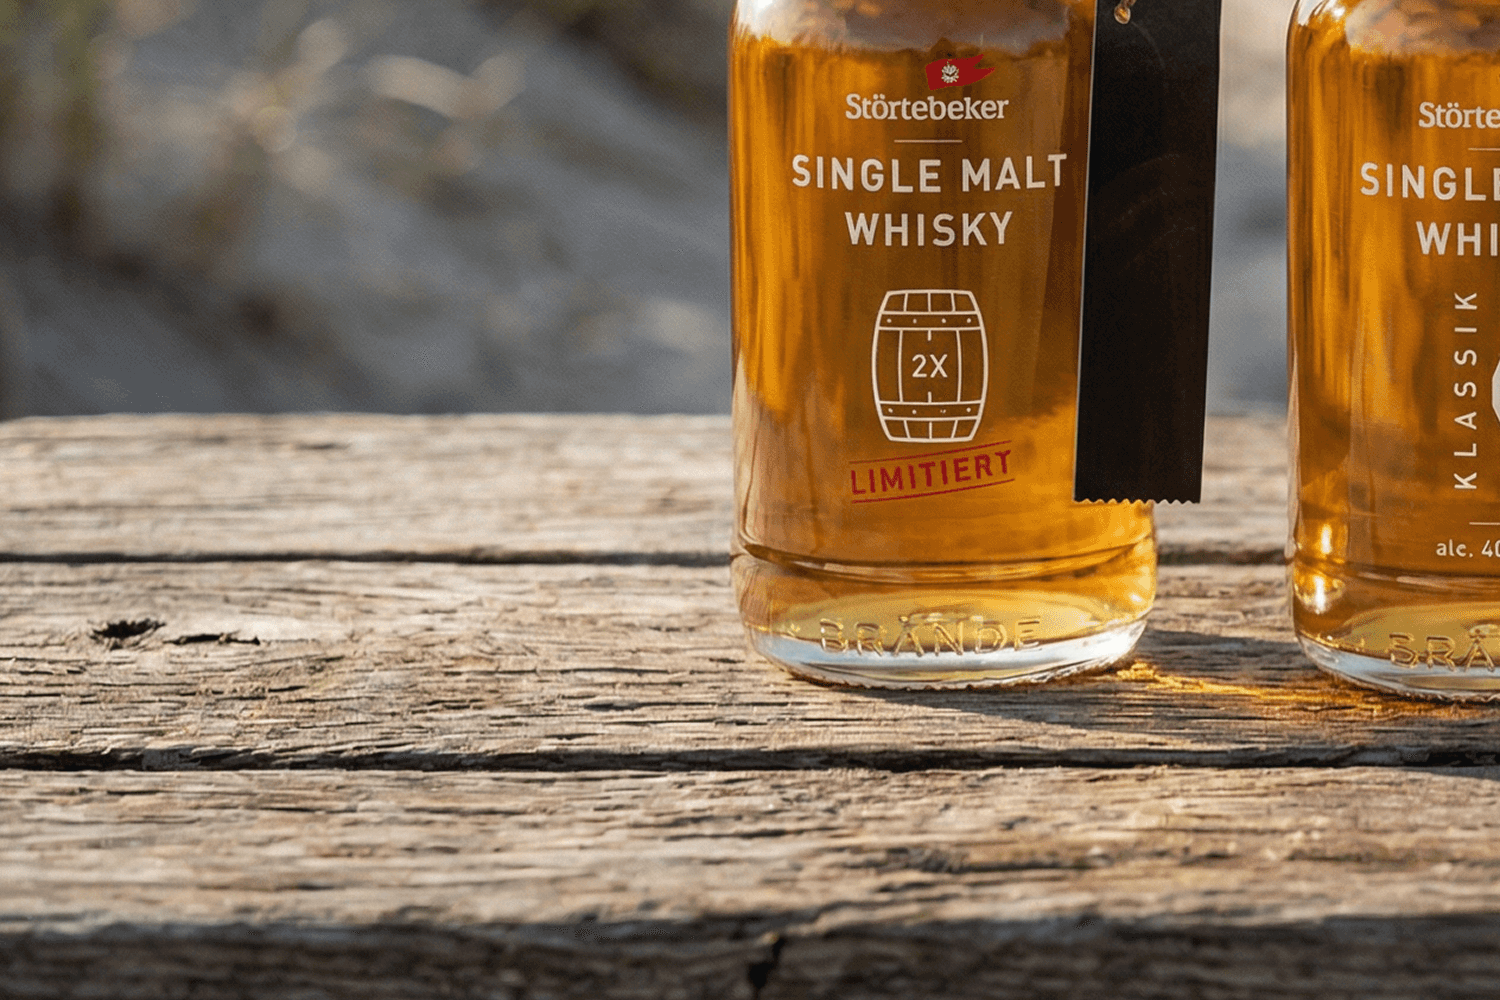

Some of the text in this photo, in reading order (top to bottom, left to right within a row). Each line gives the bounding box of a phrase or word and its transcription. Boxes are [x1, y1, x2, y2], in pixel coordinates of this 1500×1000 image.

[845, 93, 1009, 121] Störtebeker
[791, 153, 1067, 193] SINGLE MALT
[844, 211, 1013, 247] WHISKY
[911, 353, 948, 378] 2X
[1453, 292, 1478, 489] KLASSIK
[850, 450, 1012, 495] LIMITIERT
[1436, 538, 1474, 558] alc.
